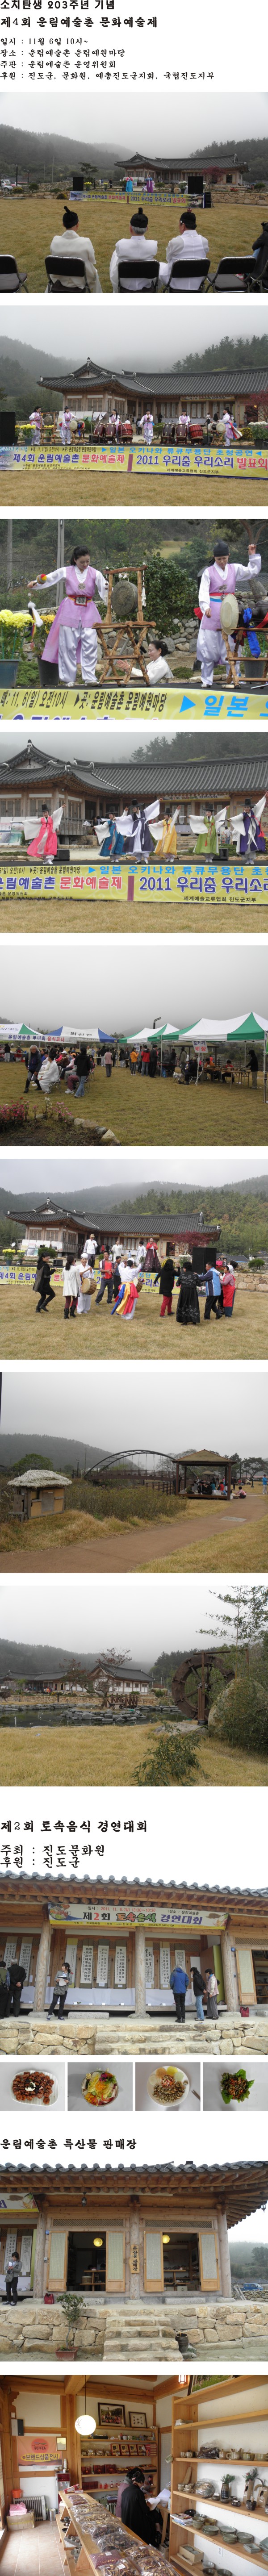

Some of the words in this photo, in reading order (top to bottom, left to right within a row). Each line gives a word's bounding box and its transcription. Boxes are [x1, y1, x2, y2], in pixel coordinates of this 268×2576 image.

[13, 454, 35, 463] 제4회
[38, 454, 79, 463] 운림예술촌
[82, 454, 125, 463] 문화예술제
[136, 455, 159, 465] 2011
[162, 455, 191, 467] 우리춤
[194, 456, 234, 468] 우리소리
[237, 457, 268, 470] 발표회
[22, 690, 40, 708] 6(일)
[39, 691, 68, 709] 오전10시
[79, 692, 90, 709] 곳:
[91, 691, 125, 710] 운림예술촌
[125, 692, 167, 712] 운림예원마당
[203, 695, 249, 717] 일본
[100, 866, 121, 874] 일본
[128, 866, 176, 874] 오키나와
[182, 866, 244, 876] 류큐무용단
[60, 876, 122, 890] 문화예술제
[139, 877, 172, 891] 2011
[176, 877, 217, 893] 우리춤
[83, 1912, 110, 1921] 제2회
[116, 1912, 156, 1923] 토속음식
[160, 1914, 203, 1925] 경연대회
